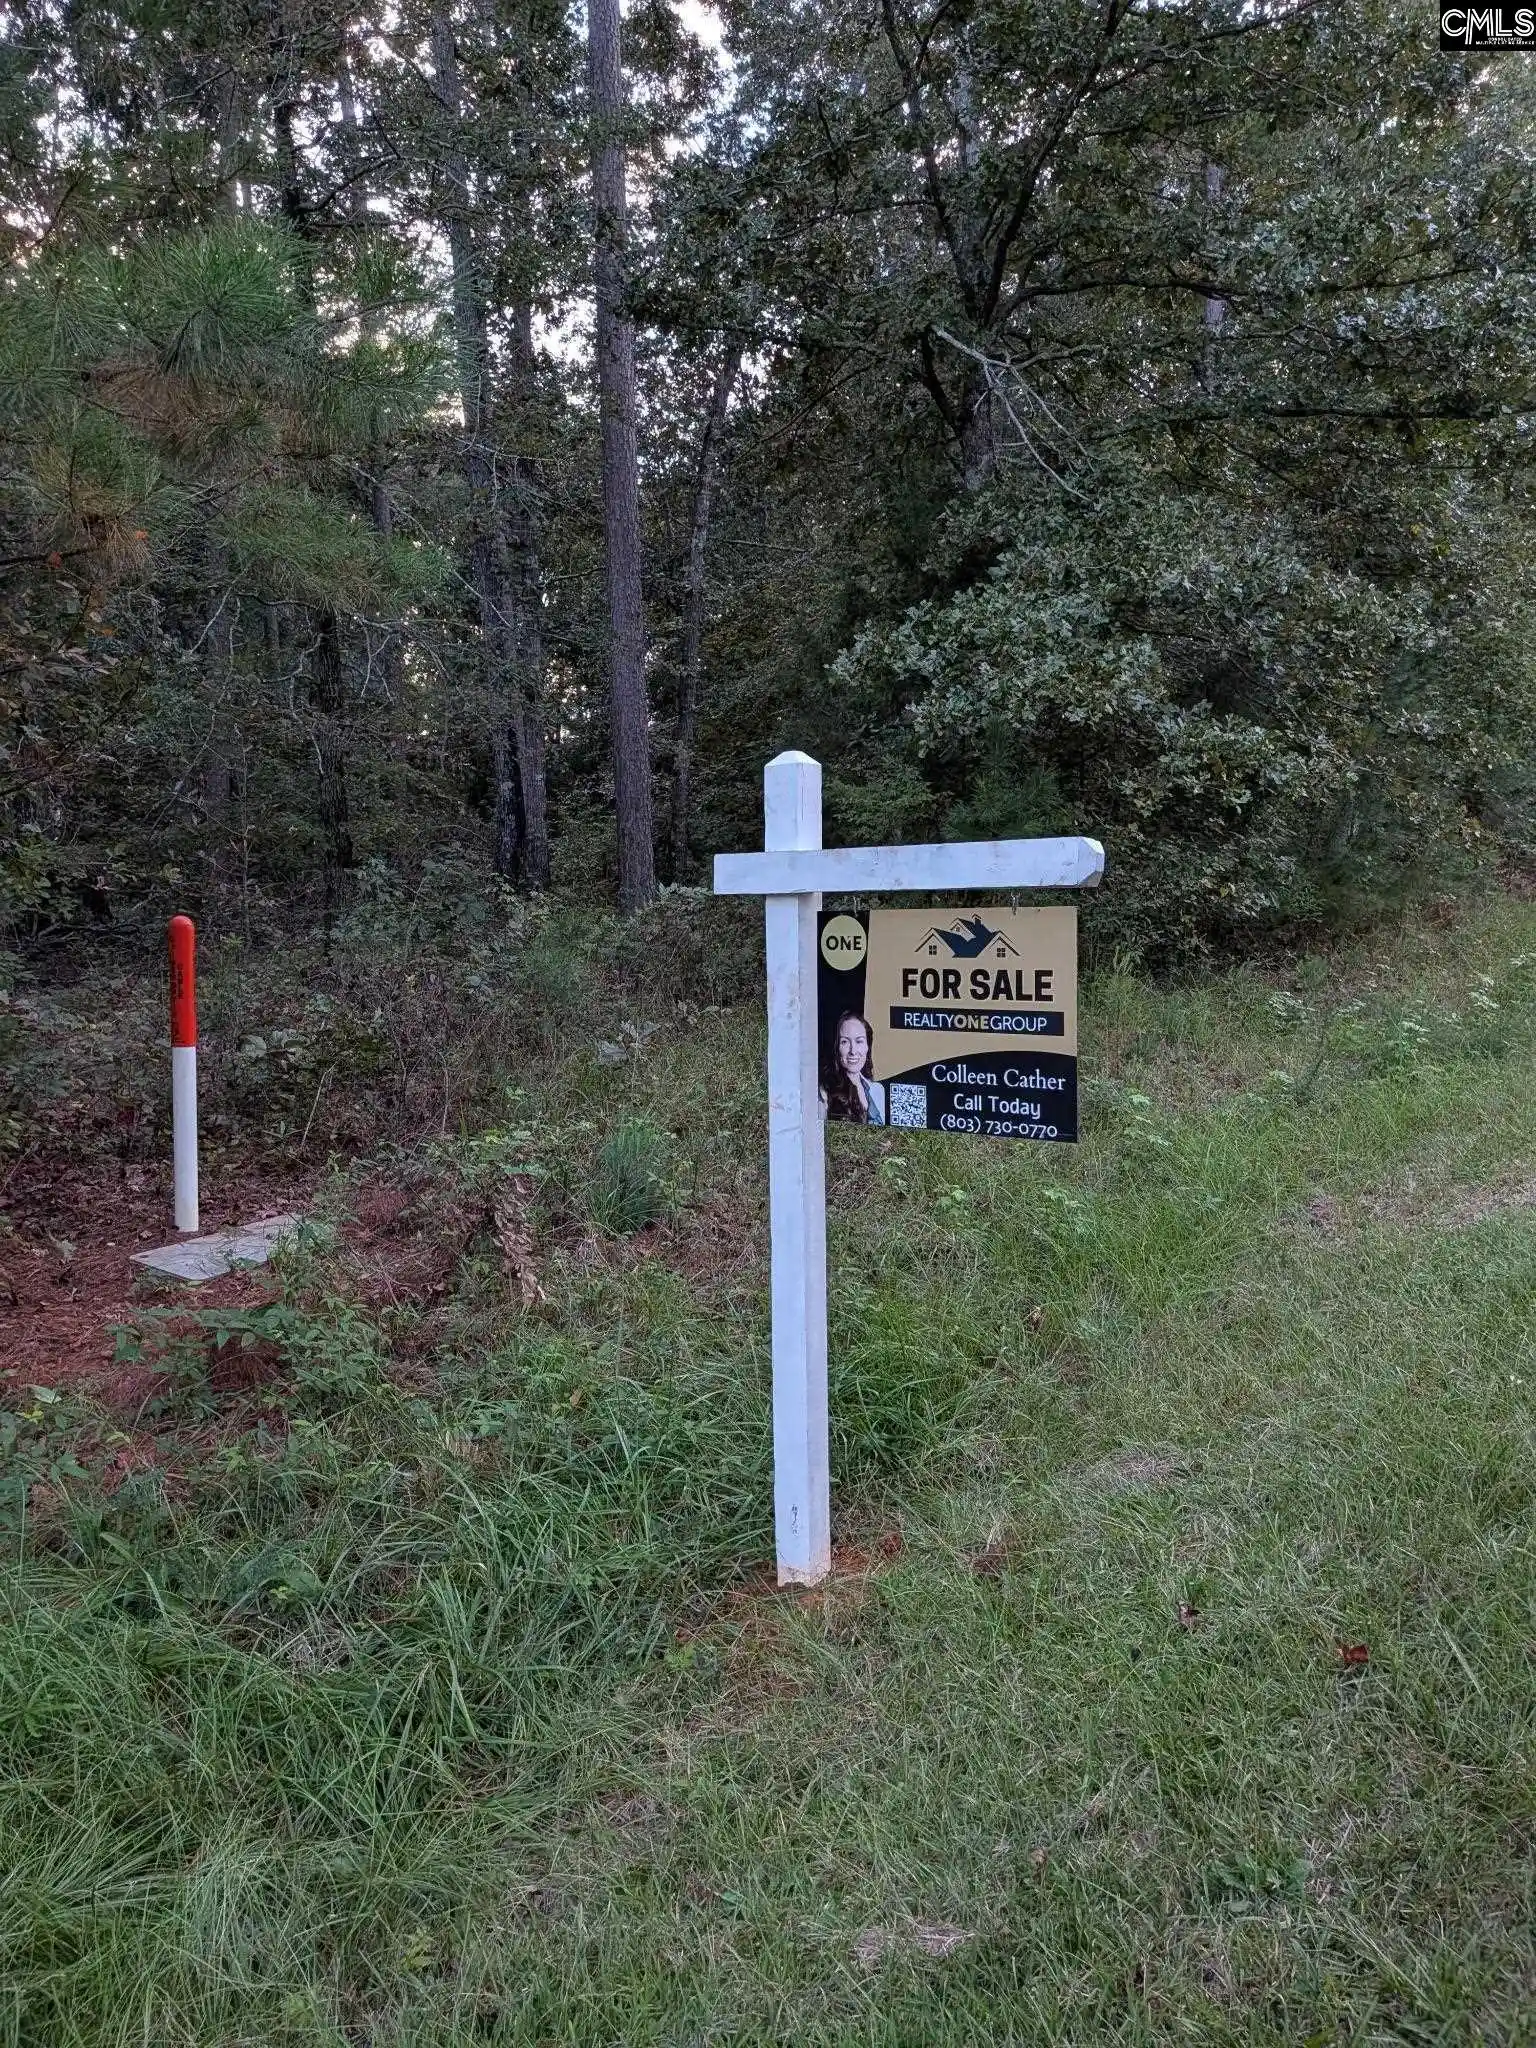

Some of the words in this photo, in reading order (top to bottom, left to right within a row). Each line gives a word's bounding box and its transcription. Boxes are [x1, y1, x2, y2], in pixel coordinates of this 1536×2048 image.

[826, 935, 862, 951] ONE
[902, 968, 961, 999] FOR
[970, 969, 1054, 1002] SALE
[931, 1065, 997, 1086] Colleen
[1003, 1069, 1066, 1090] Cather
[953, 1094, 982, 1111] Call
[988, 1096, 1040, 1119] Today
[940, 1114, 981, 1134] (803)
[986, 1120, 1057, 1138] 730-0770
